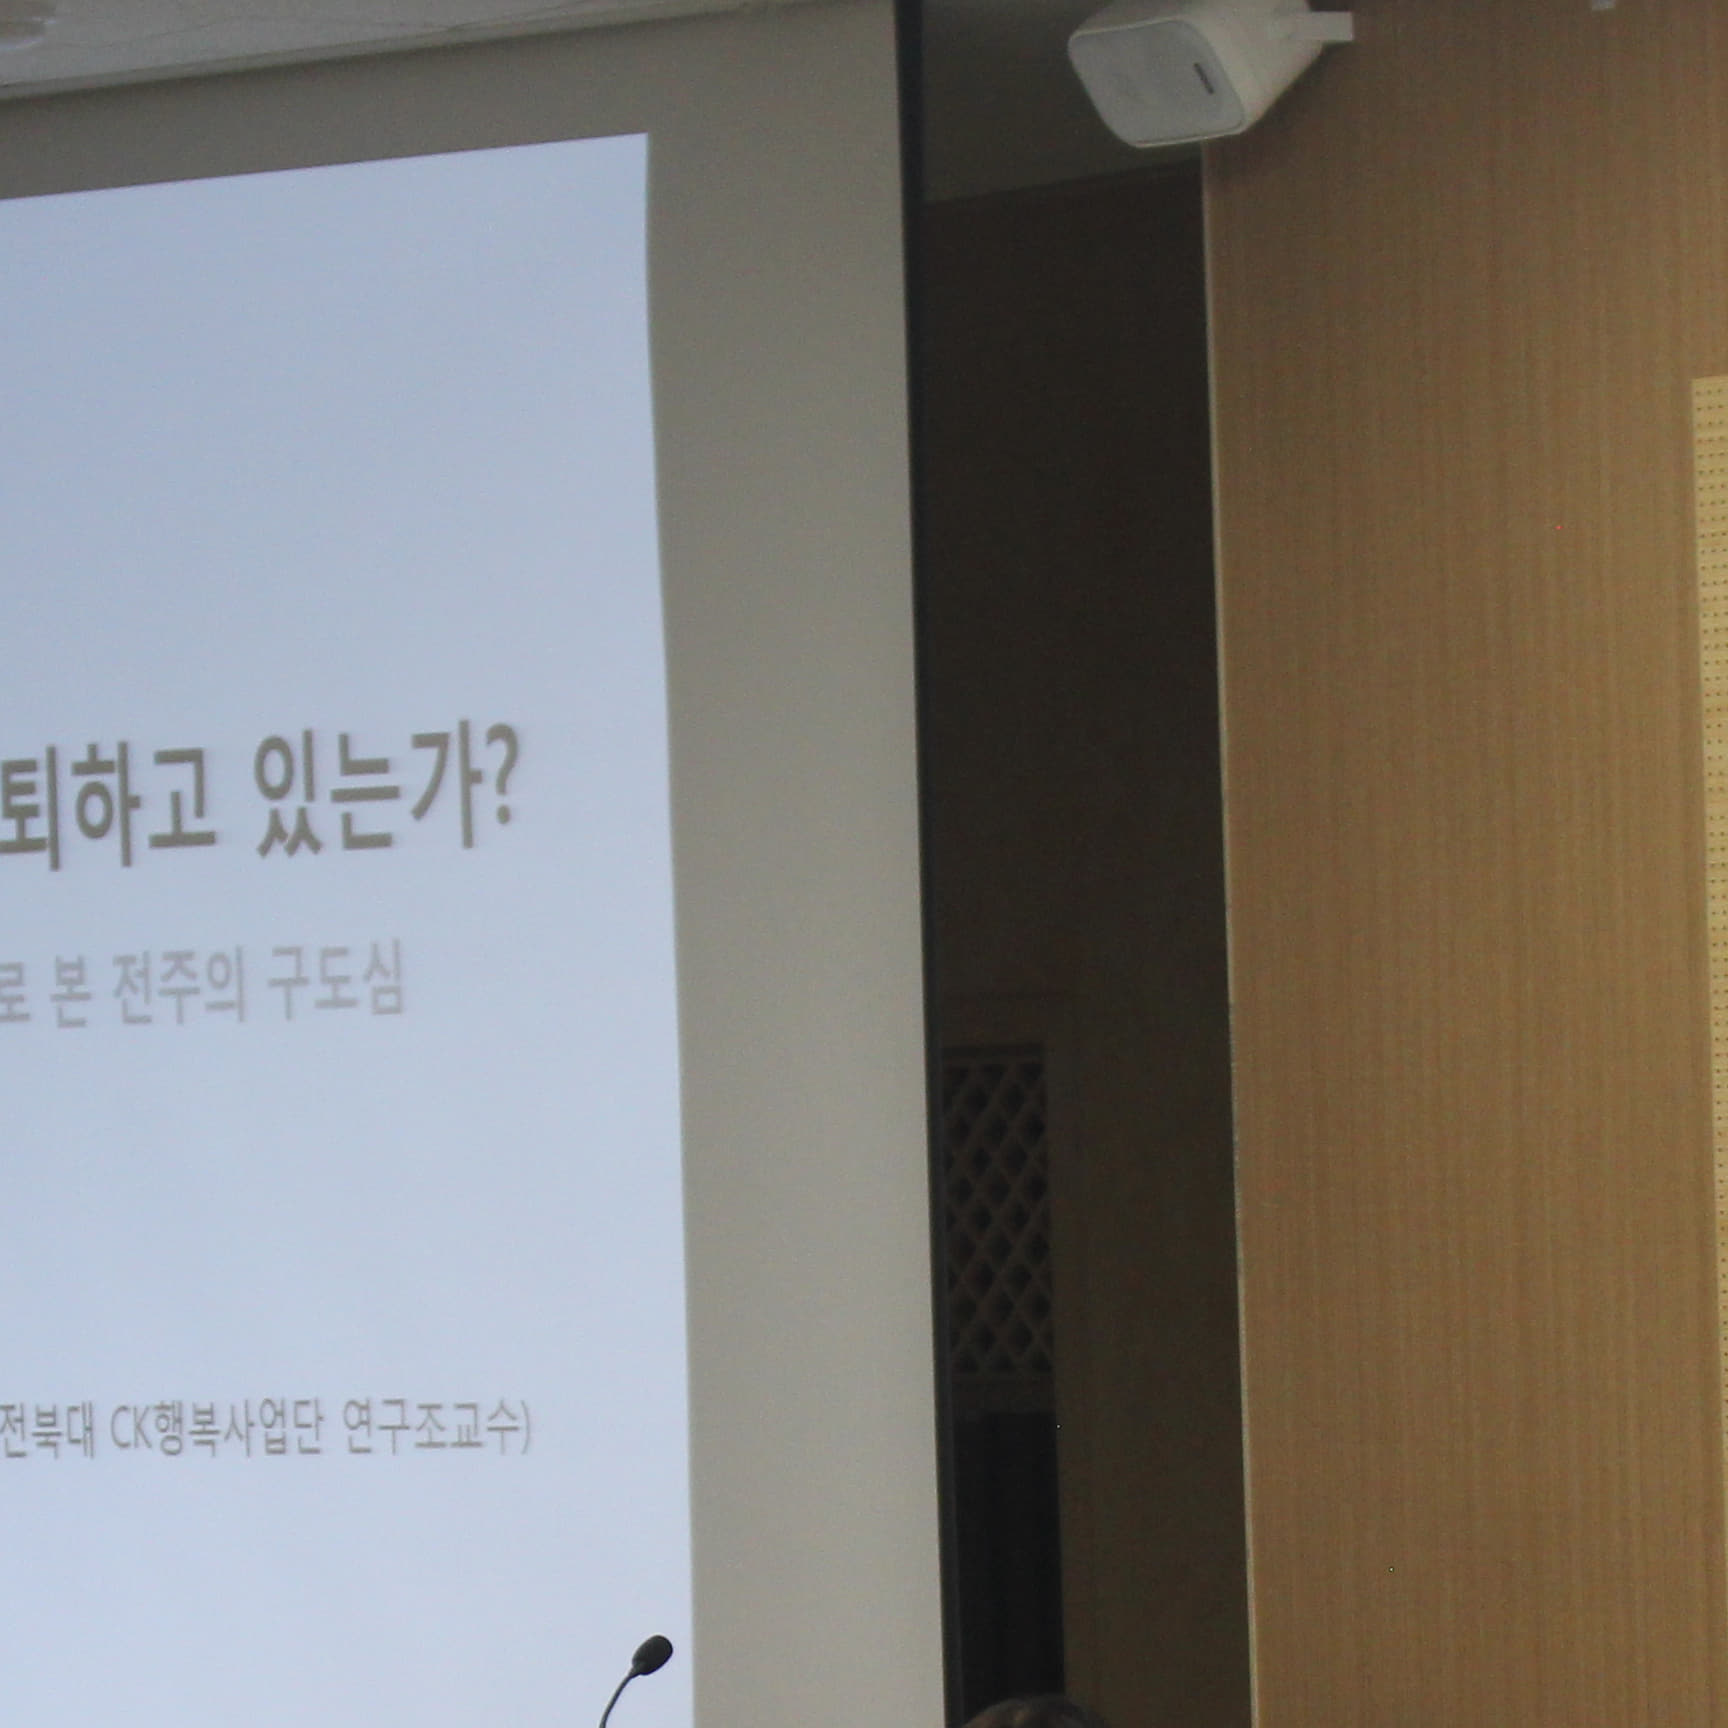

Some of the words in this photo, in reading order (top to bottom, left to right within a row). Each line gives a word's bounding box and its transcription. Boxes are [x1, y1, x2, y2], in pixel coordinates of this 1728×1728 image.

[253, 718, 521, 859] 있는가?
[49, 954, 94, 1030] 본
[111, 945, 246, 1027] 전주의
[266, 937, 405, 1022] 구도심
[110, 1396, 325, 1458] CK행복사업단
[342, 1396, 532, 1456] 연구조교수)
